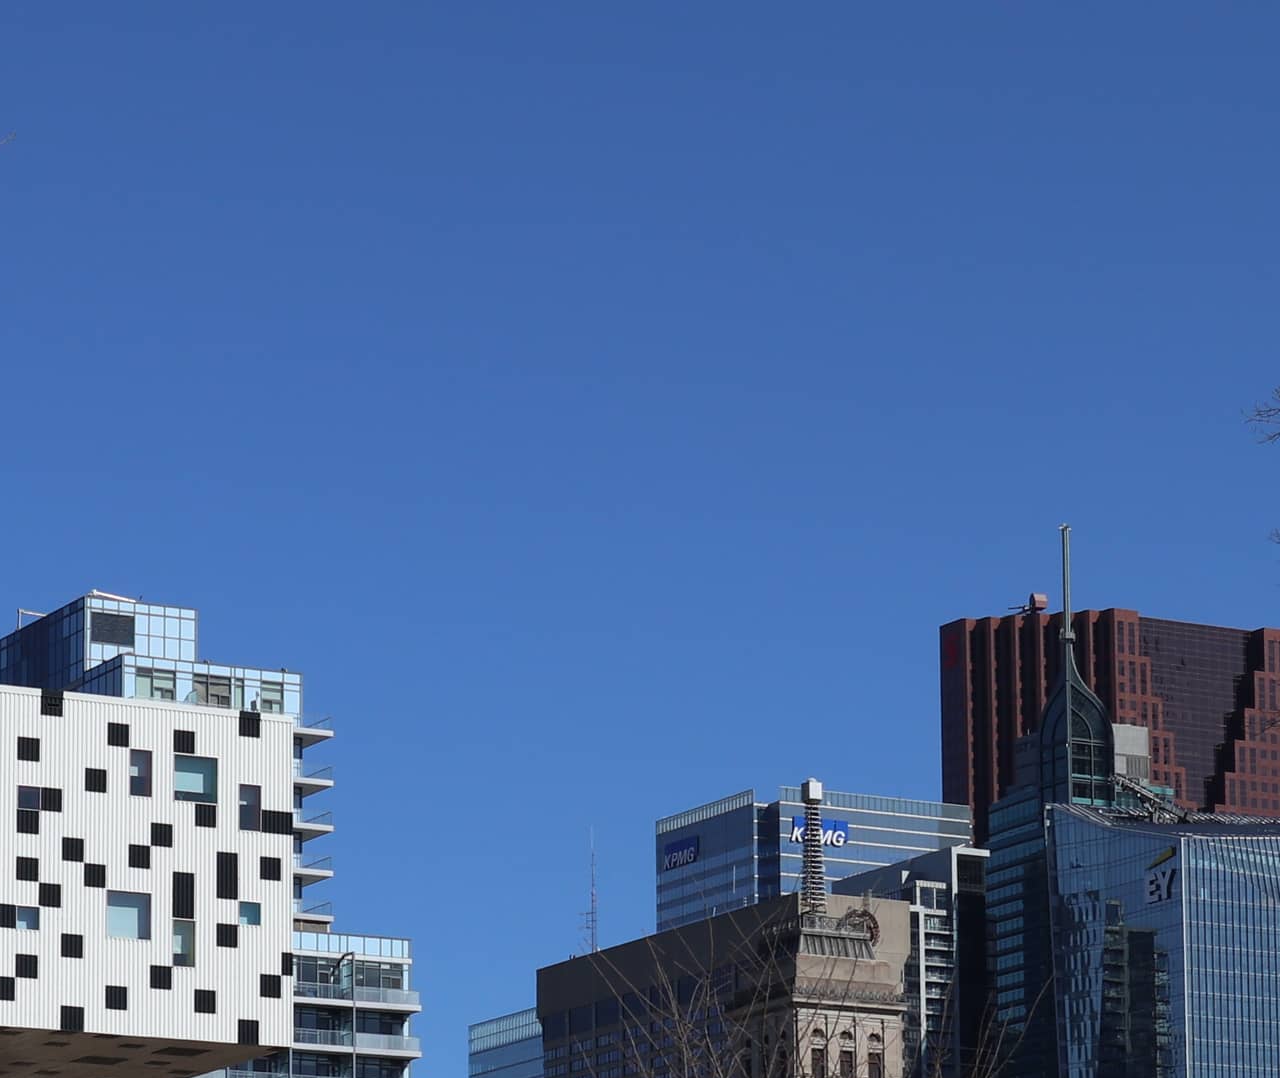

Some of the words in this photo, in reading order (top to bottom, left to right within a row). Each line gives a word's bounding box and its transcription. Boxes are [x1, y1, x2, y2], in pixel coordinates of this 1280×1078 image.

[791, 826, 846, 847] KMG
[663, 847, 696, 870] KPMG
[1145, 868, 1175, 905] EY
